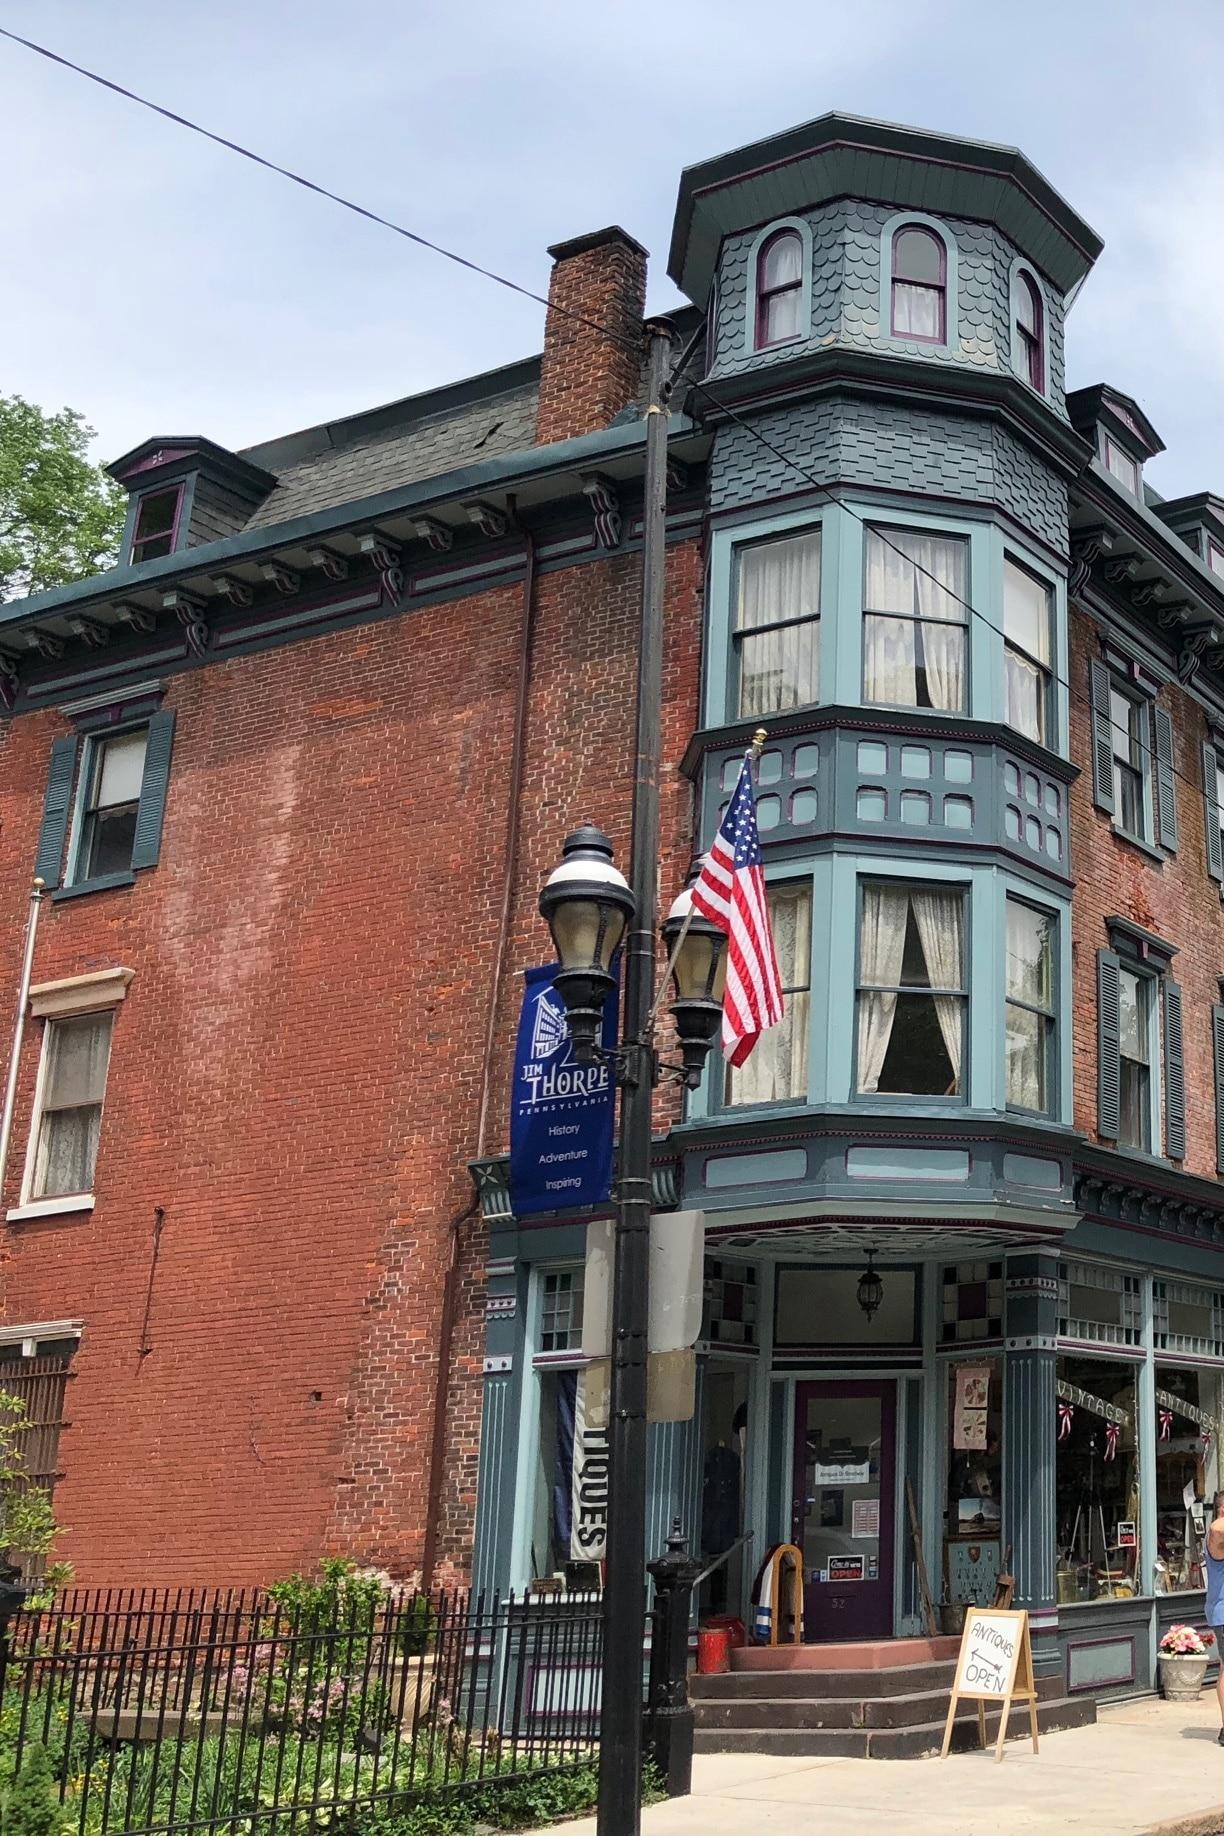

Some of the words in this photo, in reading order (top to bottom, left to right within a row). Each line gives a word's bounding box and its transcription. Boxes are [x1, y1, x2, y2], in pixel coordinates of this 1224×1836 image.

[521, 1063, 543, 1081] JIM
[526, 1063, 609, 1105] THORPE
[519, 1096, 608, 1116] PENNSYLVANIA
[548, 1125, 581, 1137] History
[538, 1149, 588, 1164] Adventure
[545, 1177, 582, 1190] Inspiring
[1057, 1379, 1124, 1424] VINTAGE
[1159, 1390, 1215, 1431] ANTIQUES
[831, 1569, 861, 1578] OPEN
[971, 1622, 1014, 1659] ANTIQUES
[966, 1664, 1006, 1692] OPEN
